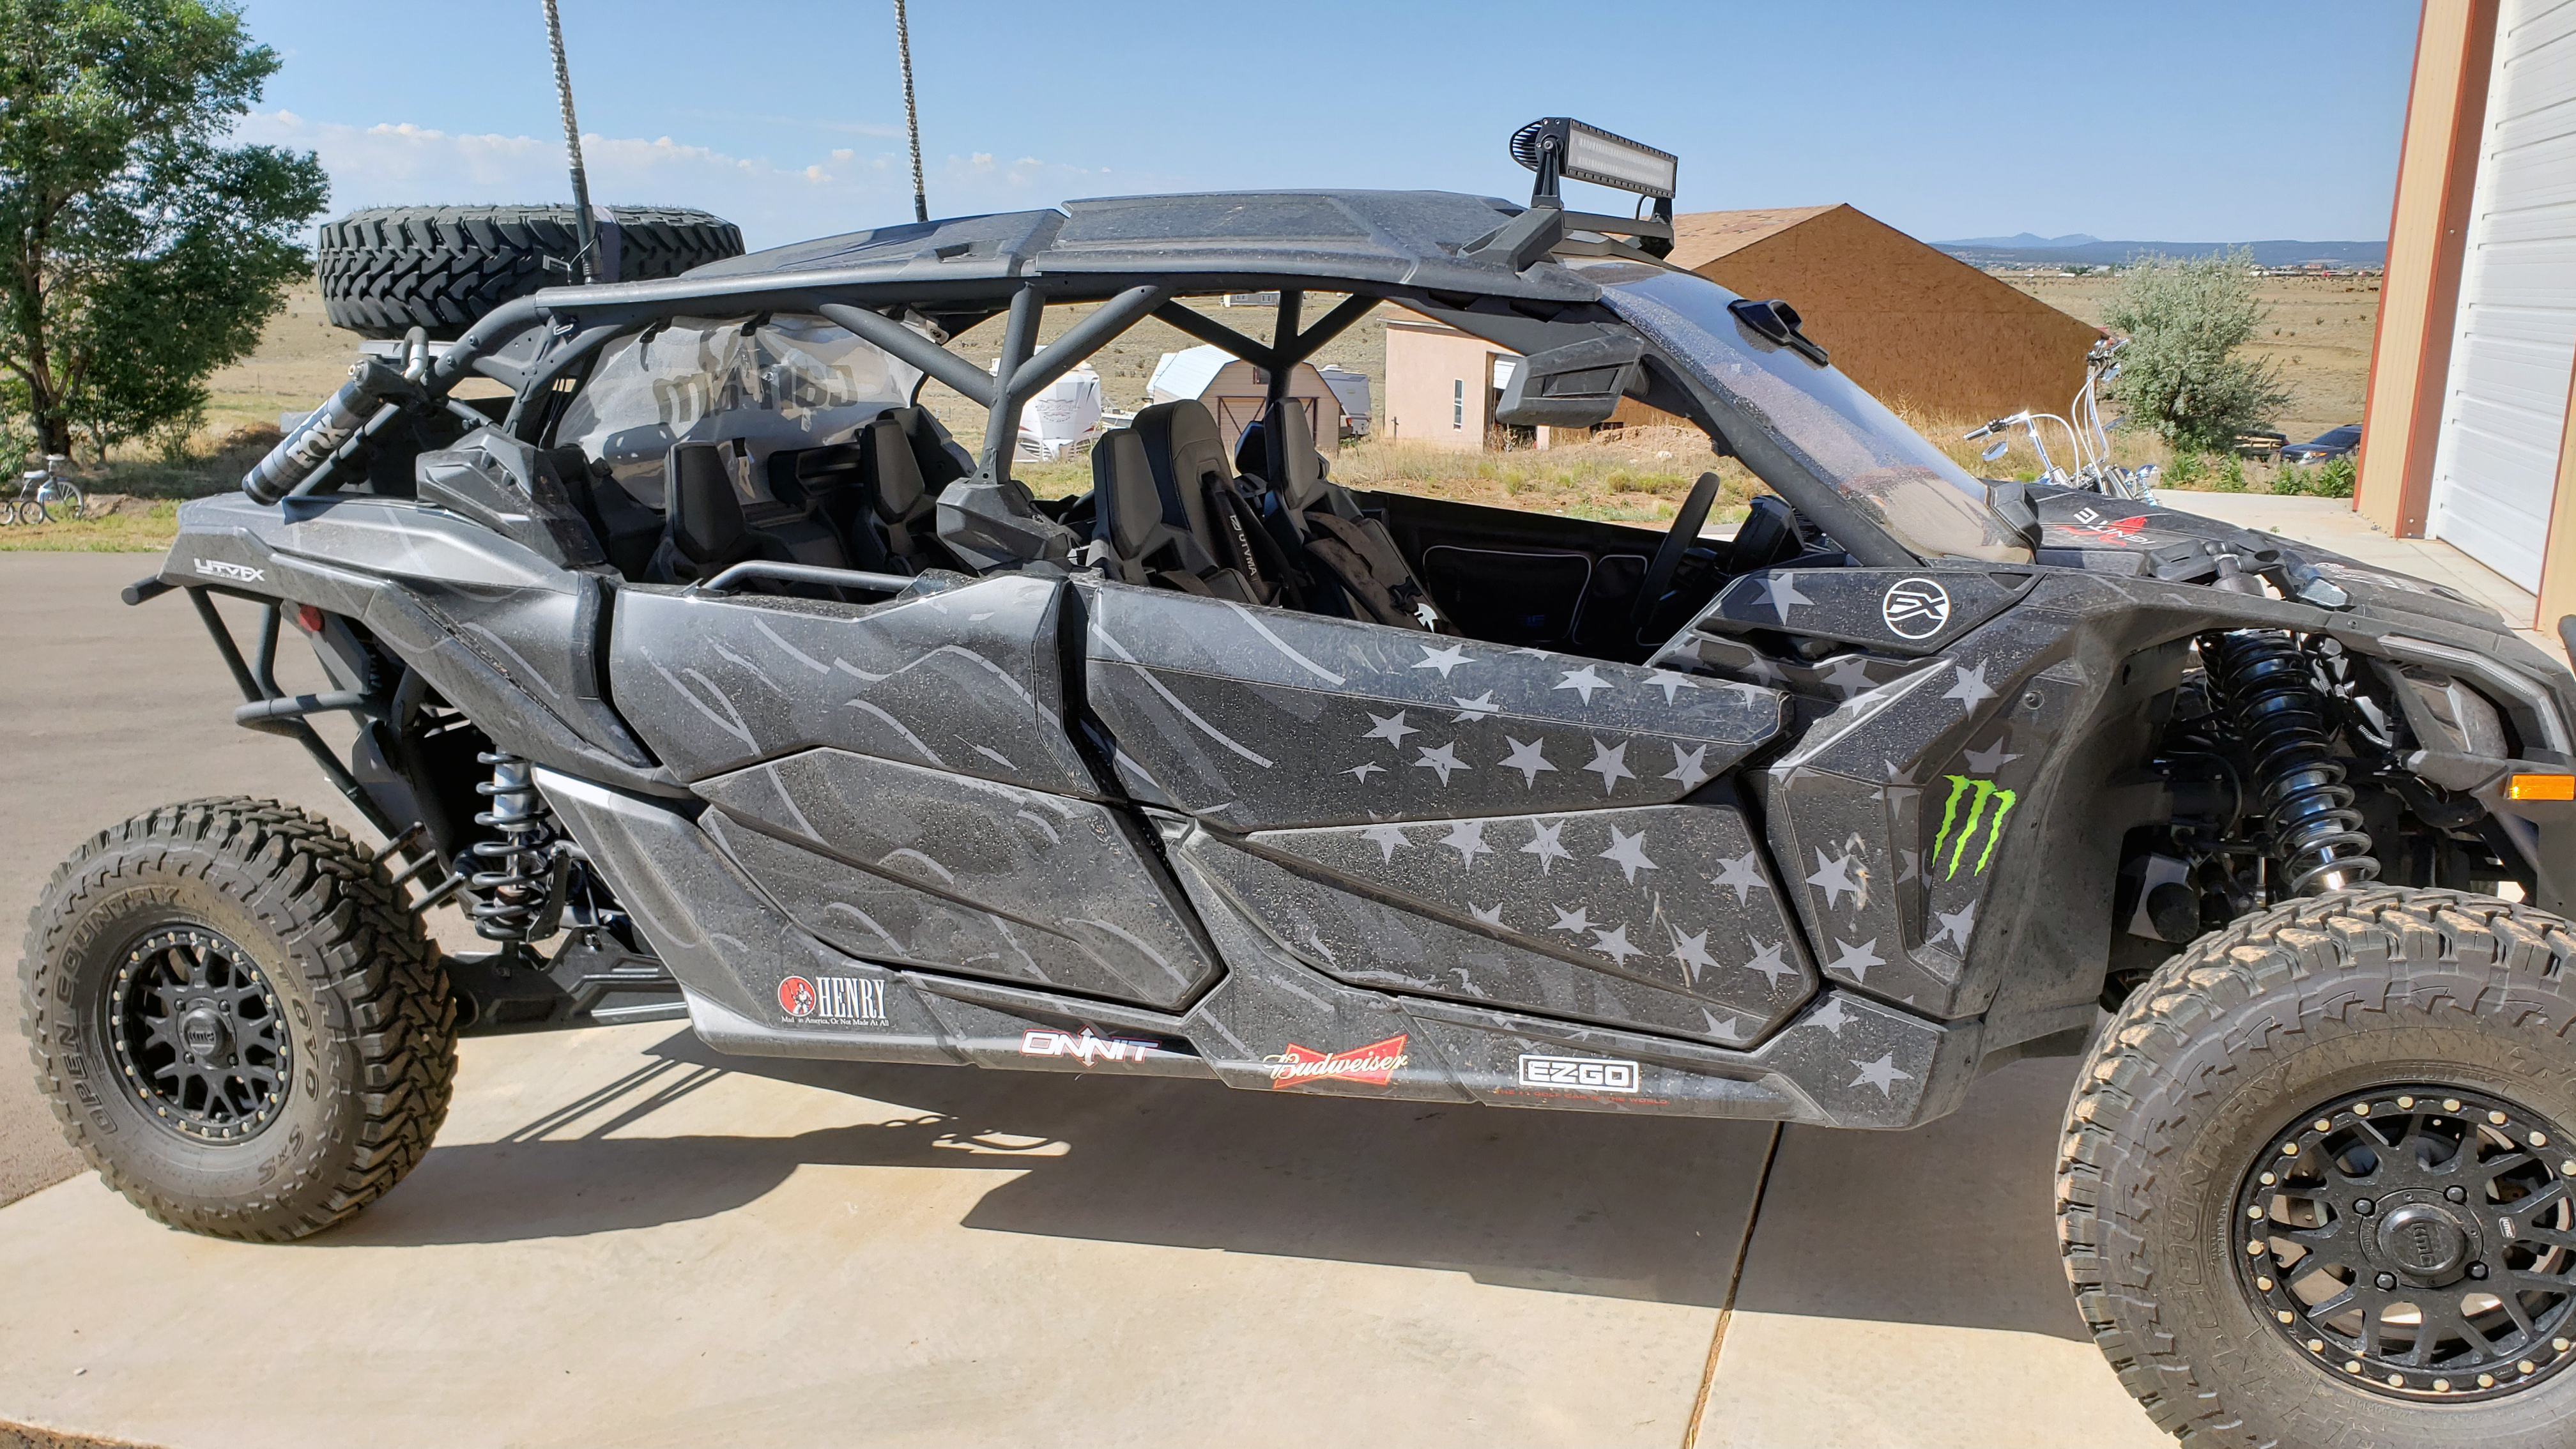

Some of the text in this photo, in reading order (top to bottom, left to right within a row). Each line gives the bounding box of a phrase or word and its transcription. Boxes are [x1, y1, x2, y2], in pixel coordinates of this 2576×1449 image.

[286, 413, 351, 469] FOX
[2073, 507, 2156, 544] IGNITE
[1239, 533, 1257, 576] UTVMA
[816, 976, 886, 1019] HENRY
[1020, 1028, 1160, 1066] ONNIT
[1262, 1051, 1408, 1080] Budweiser
[55, 1024, 118, 1134] OPEN
